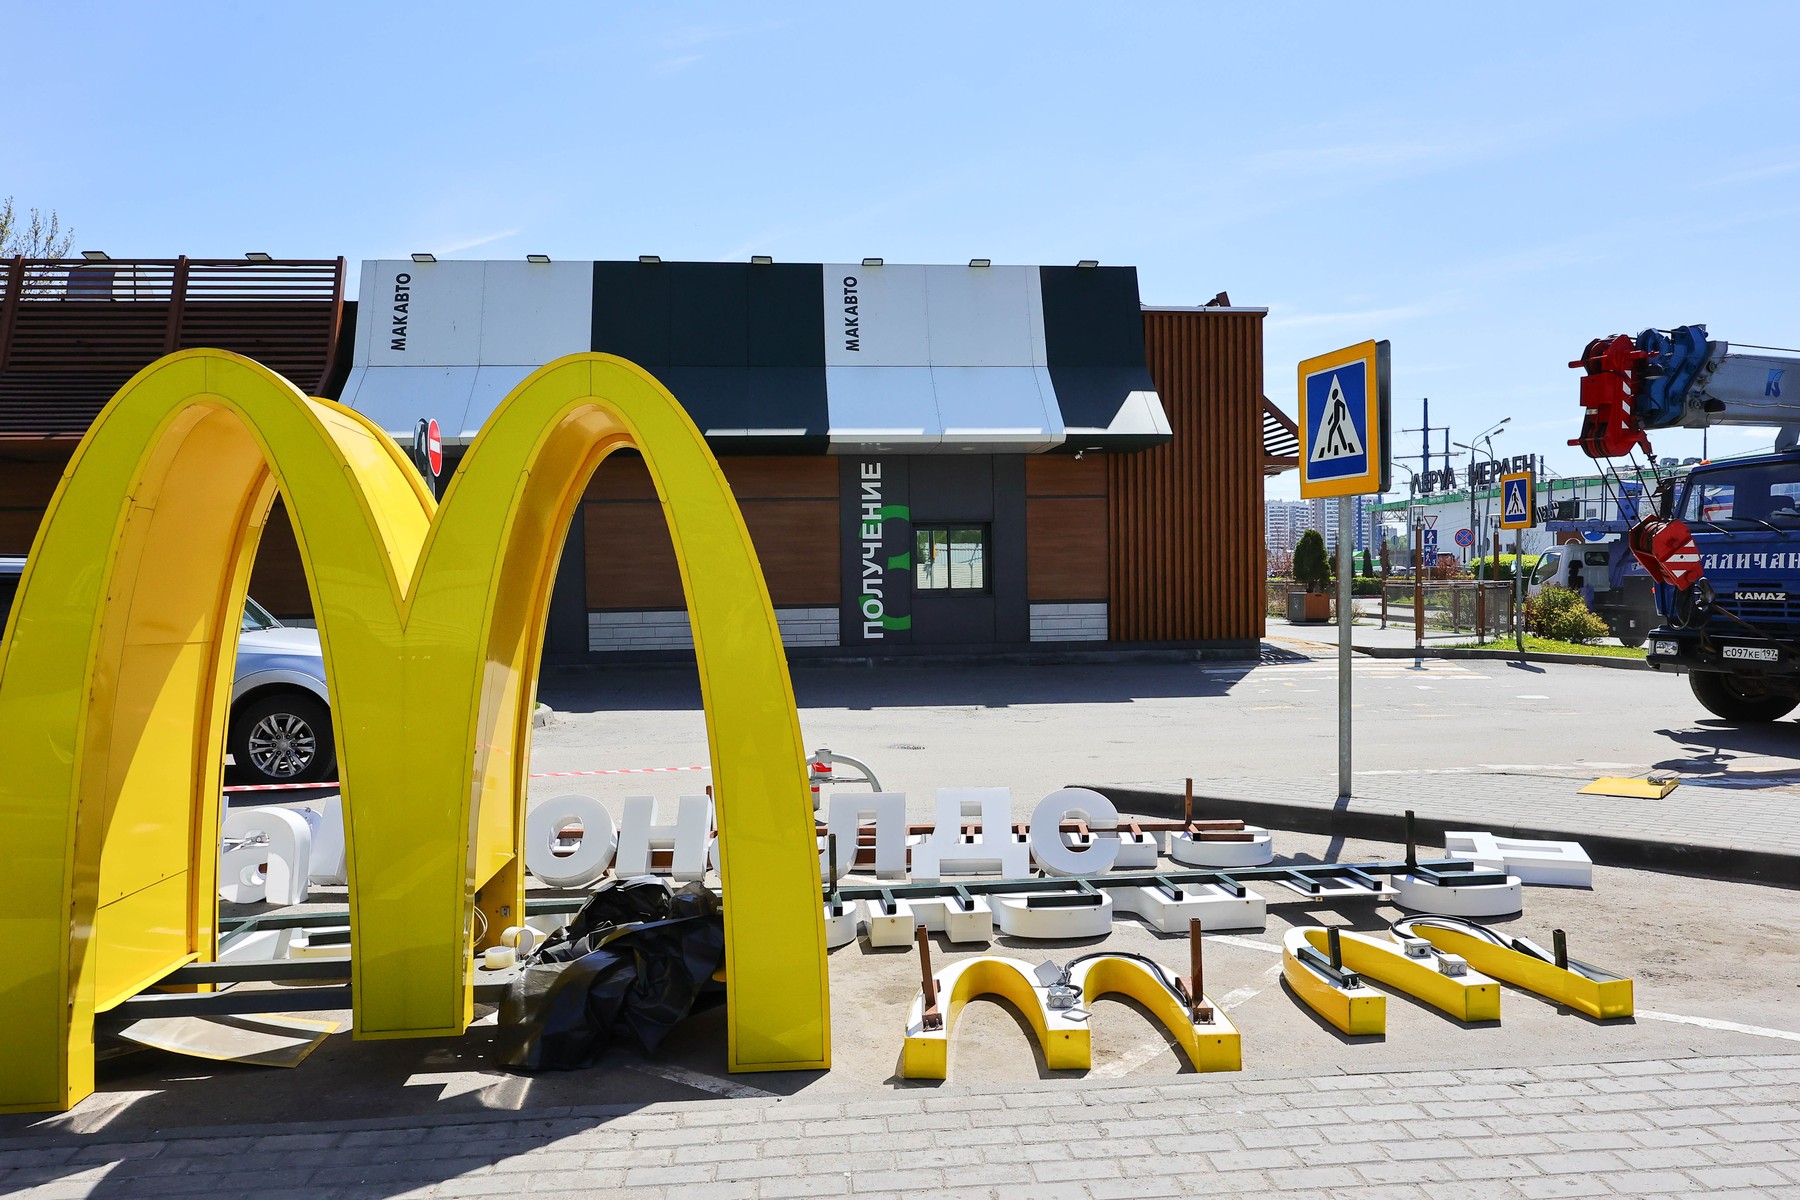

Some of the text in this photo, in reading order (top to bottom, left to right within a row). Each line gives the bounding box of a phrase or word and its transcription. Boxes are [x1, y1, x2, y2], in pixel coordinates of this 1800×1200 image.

[391, 273, 411, 351] МАКАВТО
[843, 276, 860, 351] МАКАВТО
[1411, 467, 1457, 494] ЛЕРУА
[861, 463, 884, 639] ПОЛУЧЕНИЕ
[1700, 552, 1800, 569] АЛИЧАН
[1734, 592, 1786, 601] KAMAZ
